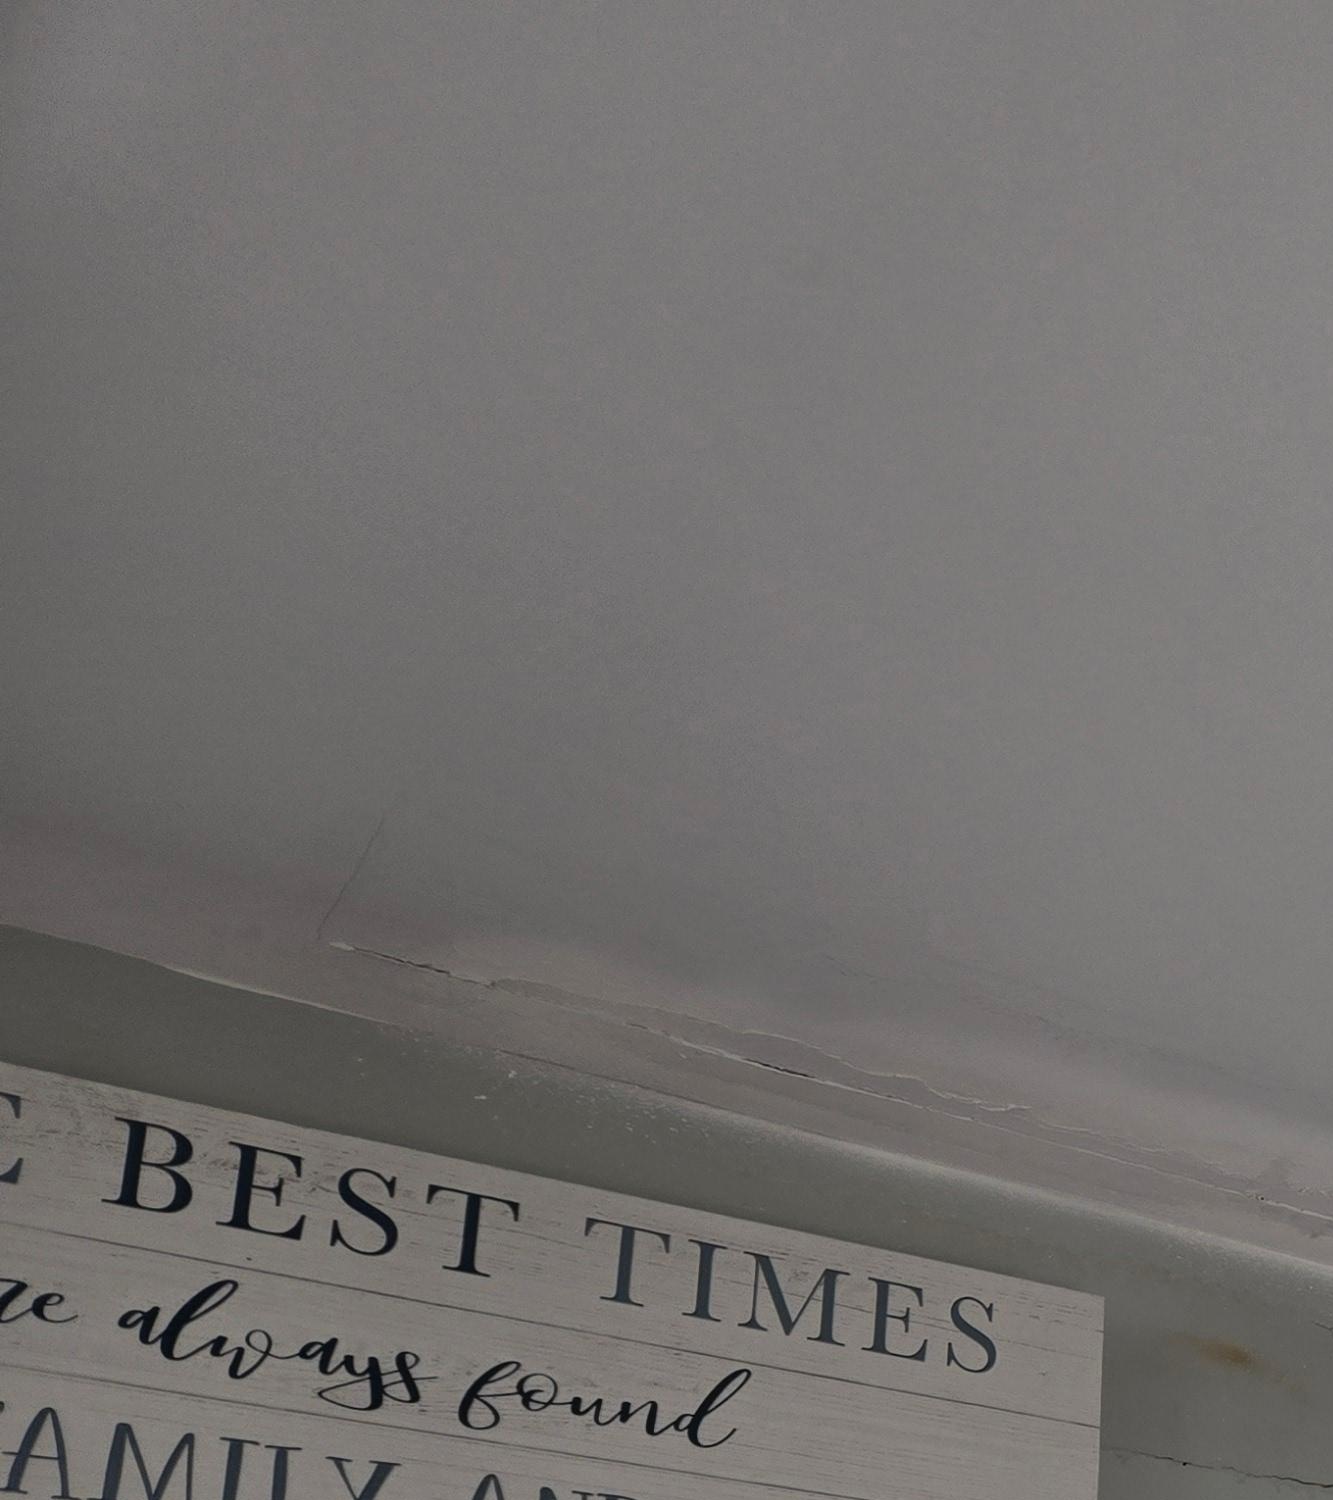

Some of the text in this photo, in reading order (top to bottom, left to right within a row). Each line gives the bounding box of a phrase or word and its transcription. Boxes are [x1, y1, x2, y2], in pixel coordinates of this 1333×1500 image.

[101, 1117, 519, 1277] BEST
[585, 1217, 998, 1375] TIMES
[118, 1279, 433, 1413] always
[457, 1361, 751, 1449] found
